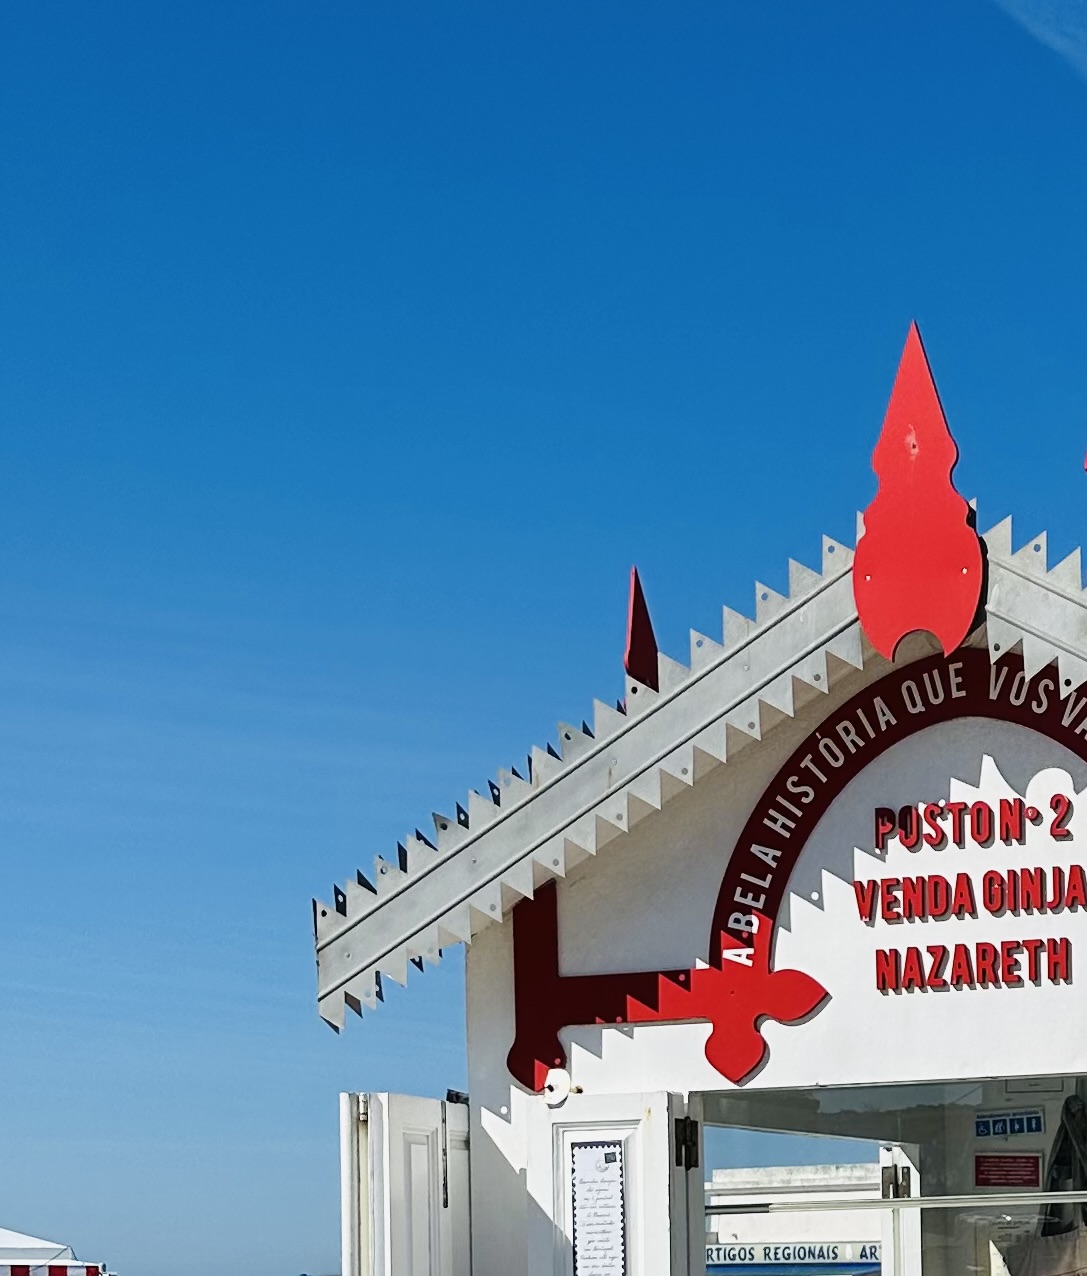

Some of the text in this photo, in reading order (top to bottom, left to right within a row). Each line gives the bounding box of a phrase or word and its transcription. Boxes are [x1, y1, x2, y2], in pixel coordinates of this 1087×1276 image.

[901, 661, 967, 715] QUE
[989, 663, 1055, 714] VOS
[762, 696, 898, 838] HISTÓRIA
[1049, 793, 1073, 840] 2
[728, 843, 783, 935] BELA
[853, 872, 977, 926] VENDA
[722, 947, 755, 967] A
[875, 937, 1073, 995] NAZARETH
[763, 1245, 839, 1262] REGIONAIS
[859, 1244, 882, 1261] AR
